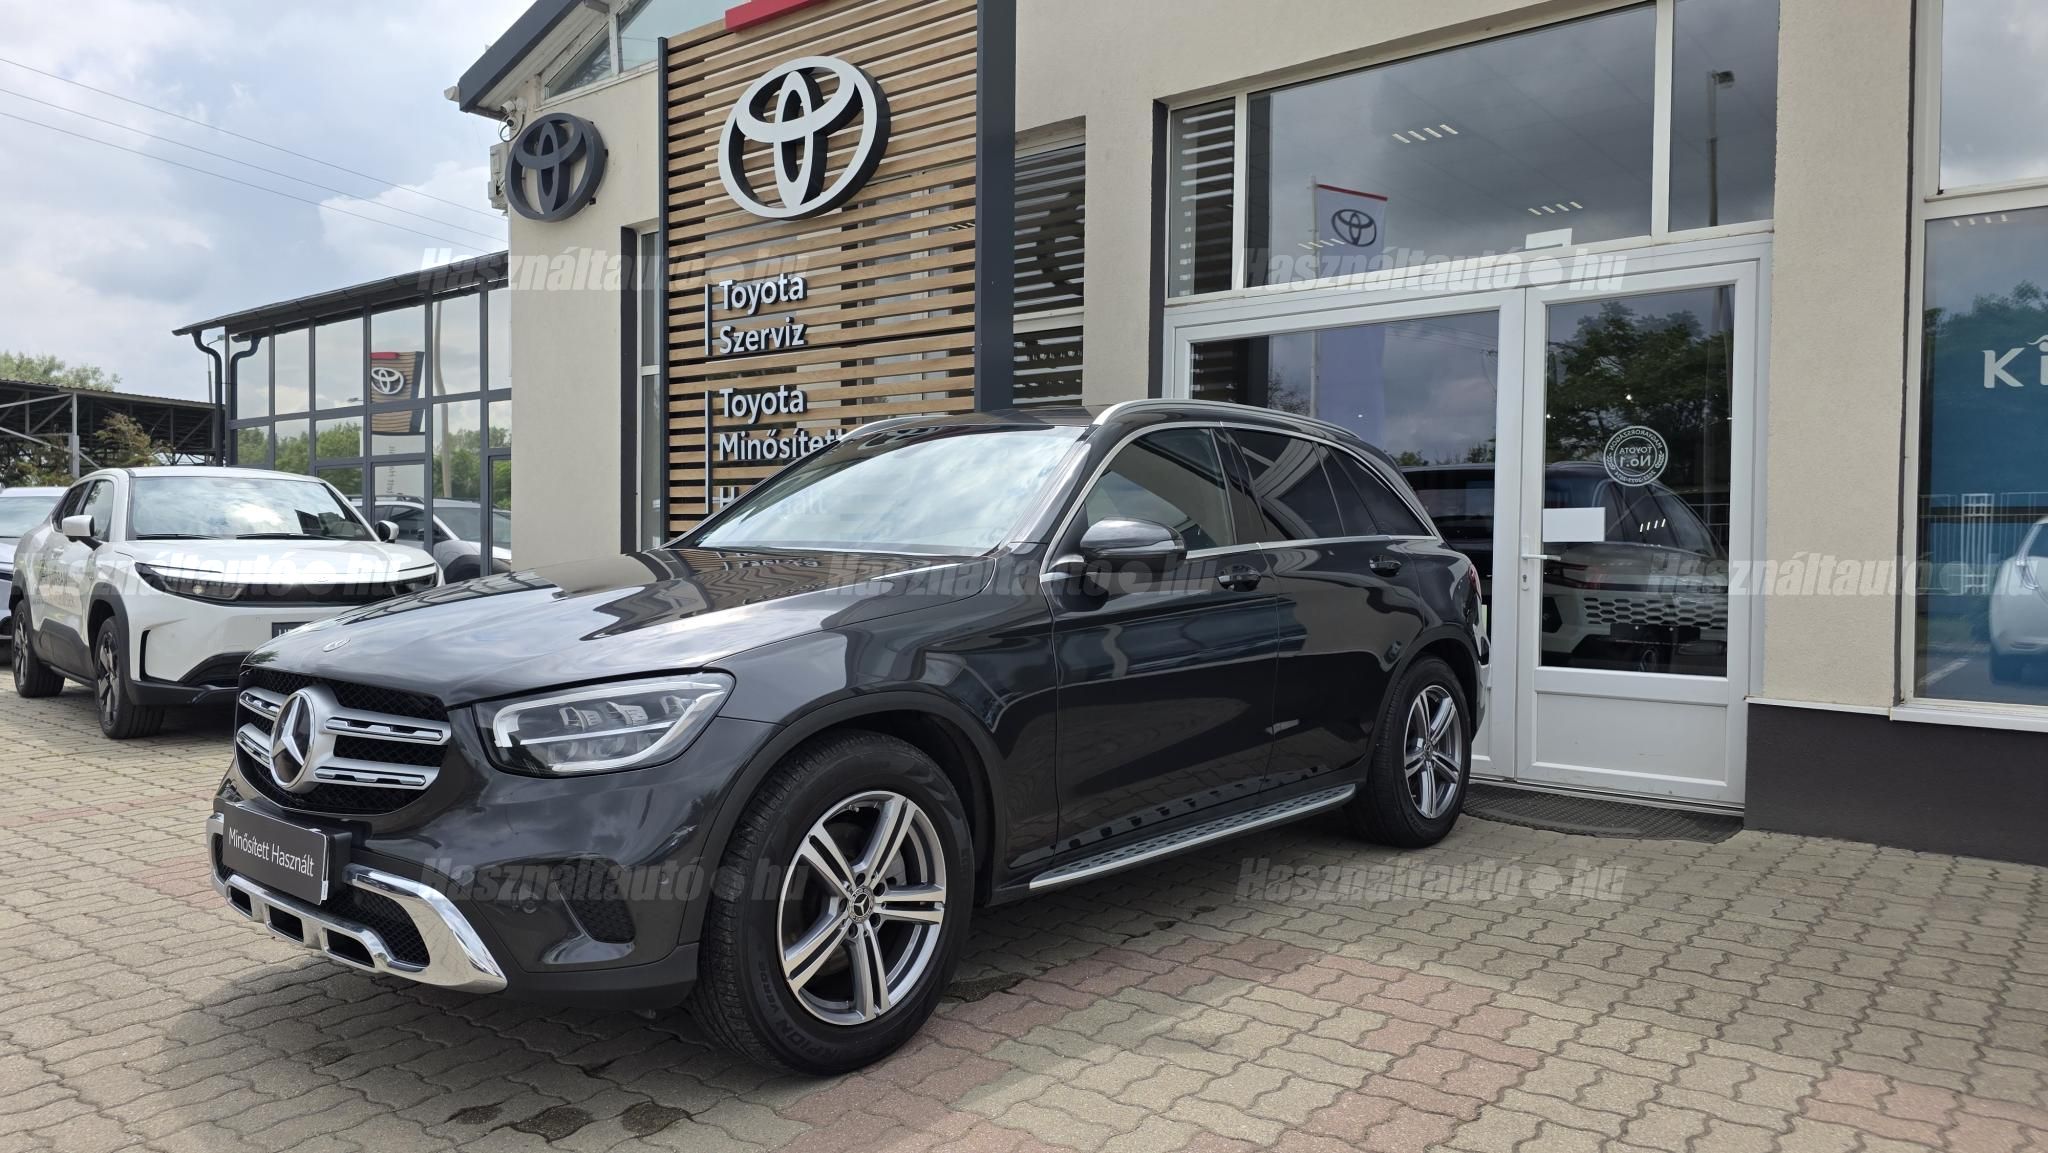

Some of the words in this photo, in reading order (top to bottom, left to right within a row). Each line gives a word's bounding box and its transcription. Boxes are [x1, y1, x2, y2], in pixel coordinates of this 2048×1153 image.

[719, 273, 806, 314] Toyota
[719, 316, 806, 354] Szerviz
[719, 385, 806, 423] Toyota
[228, 826, 270, 861] Minősített
[271, 843, 315, 878] Használt
